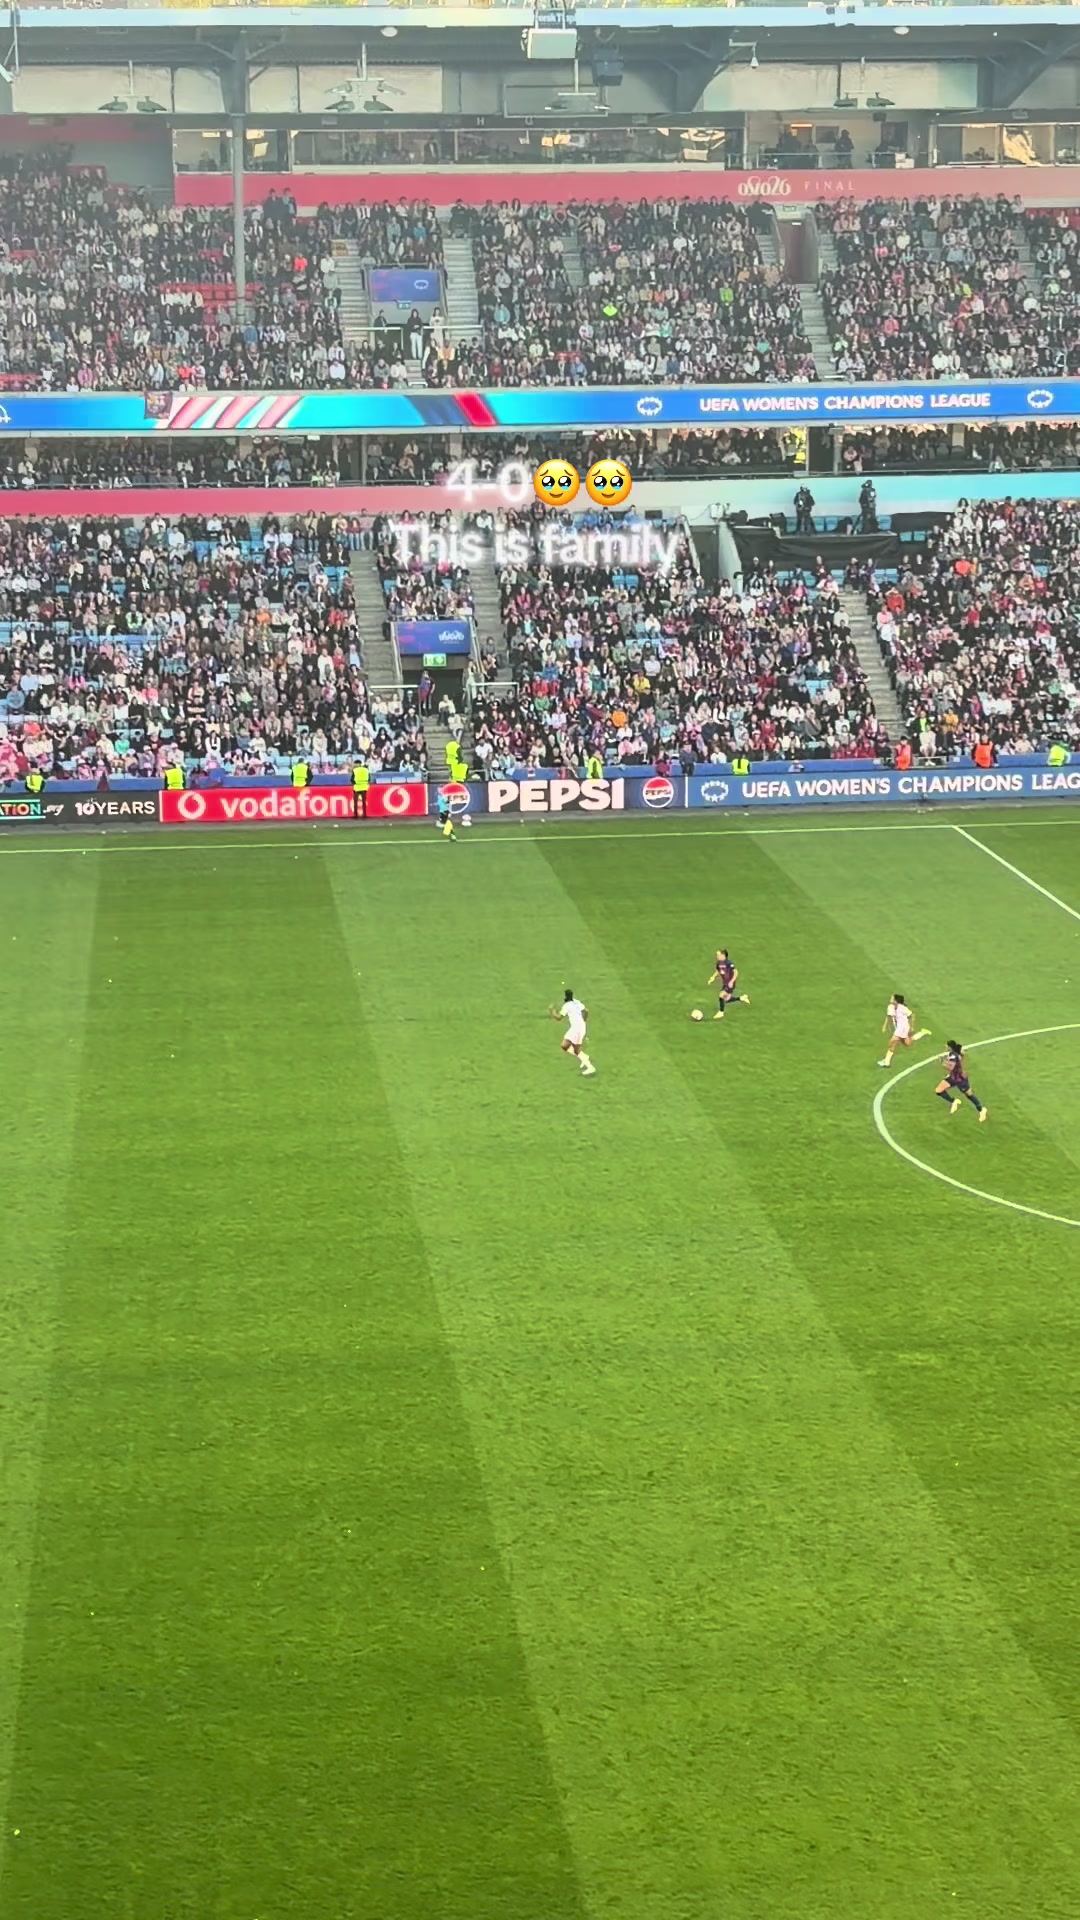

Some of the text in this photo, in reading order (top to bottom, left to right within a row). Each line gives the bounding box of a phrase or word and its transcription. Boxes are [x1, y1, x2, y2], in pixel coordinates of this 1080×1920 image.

[804, 181, 856, 191] FINAL
[700, 392, 991, 412] UEFA WOMEN'S CHAMPIONS LEAGUE
[488, 778, 625, 812] PEPSI
[741, 780, 790, 798] UEFA
[795, 777, 890, 797] WOMEN'S
[898, 774, 1023, 794] CHAMPIONS
